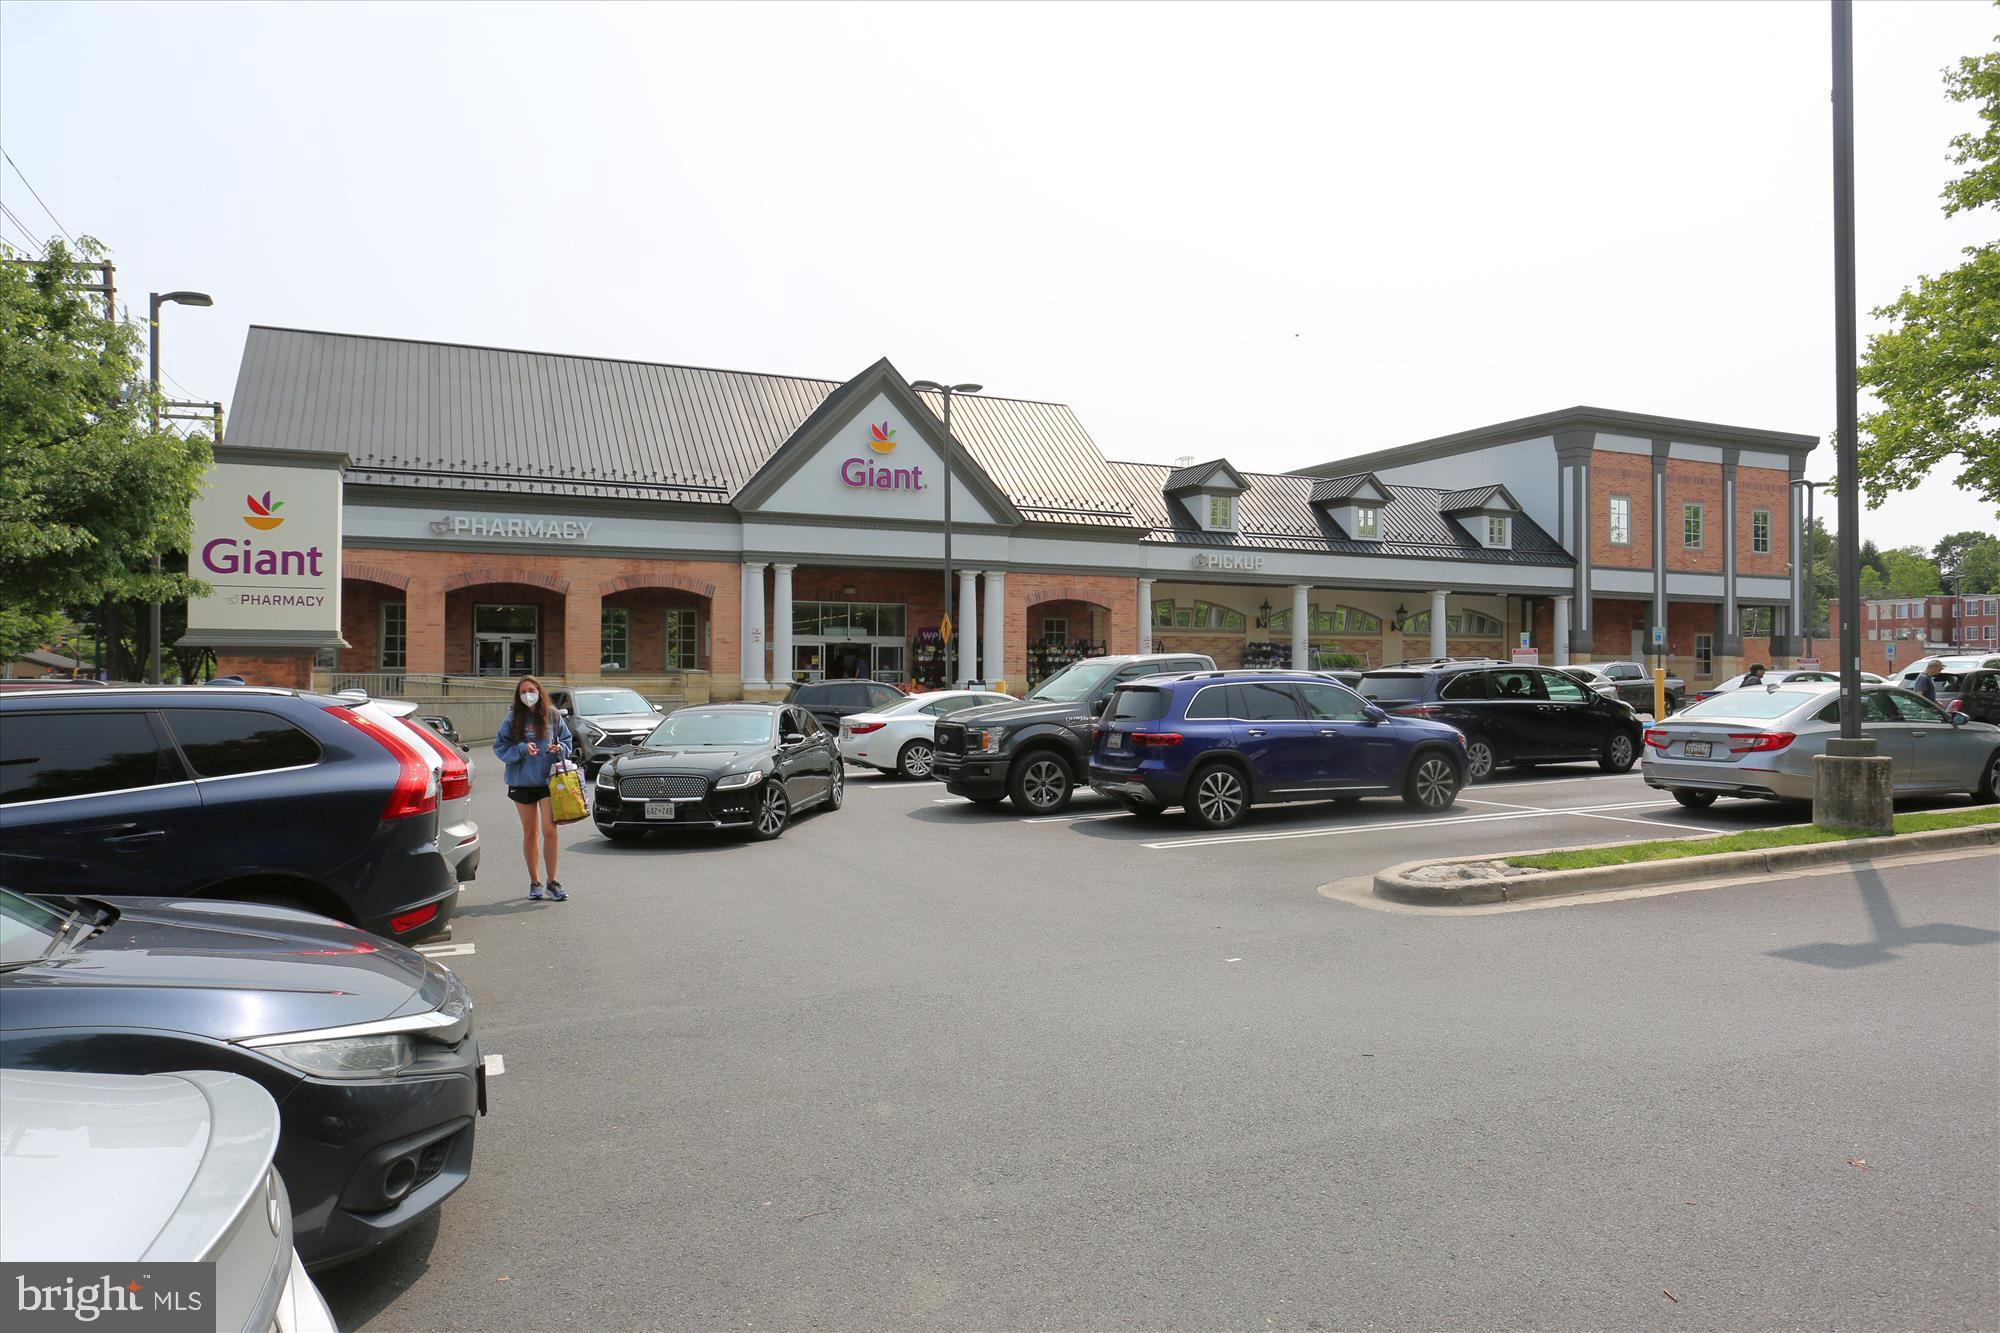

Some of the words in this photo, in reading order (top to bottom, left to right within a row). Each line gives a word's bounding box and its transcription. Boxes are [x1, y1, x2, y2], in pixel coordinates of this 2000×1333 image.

[841, 457, 923, 491] Giant
[453, 515, 594, 541] PHARMACY
[202, 538, 323, 577] Giant
[1208, 553, 1265, 571] PICKUP
[240, 594, 325, 607] PHARMACY
